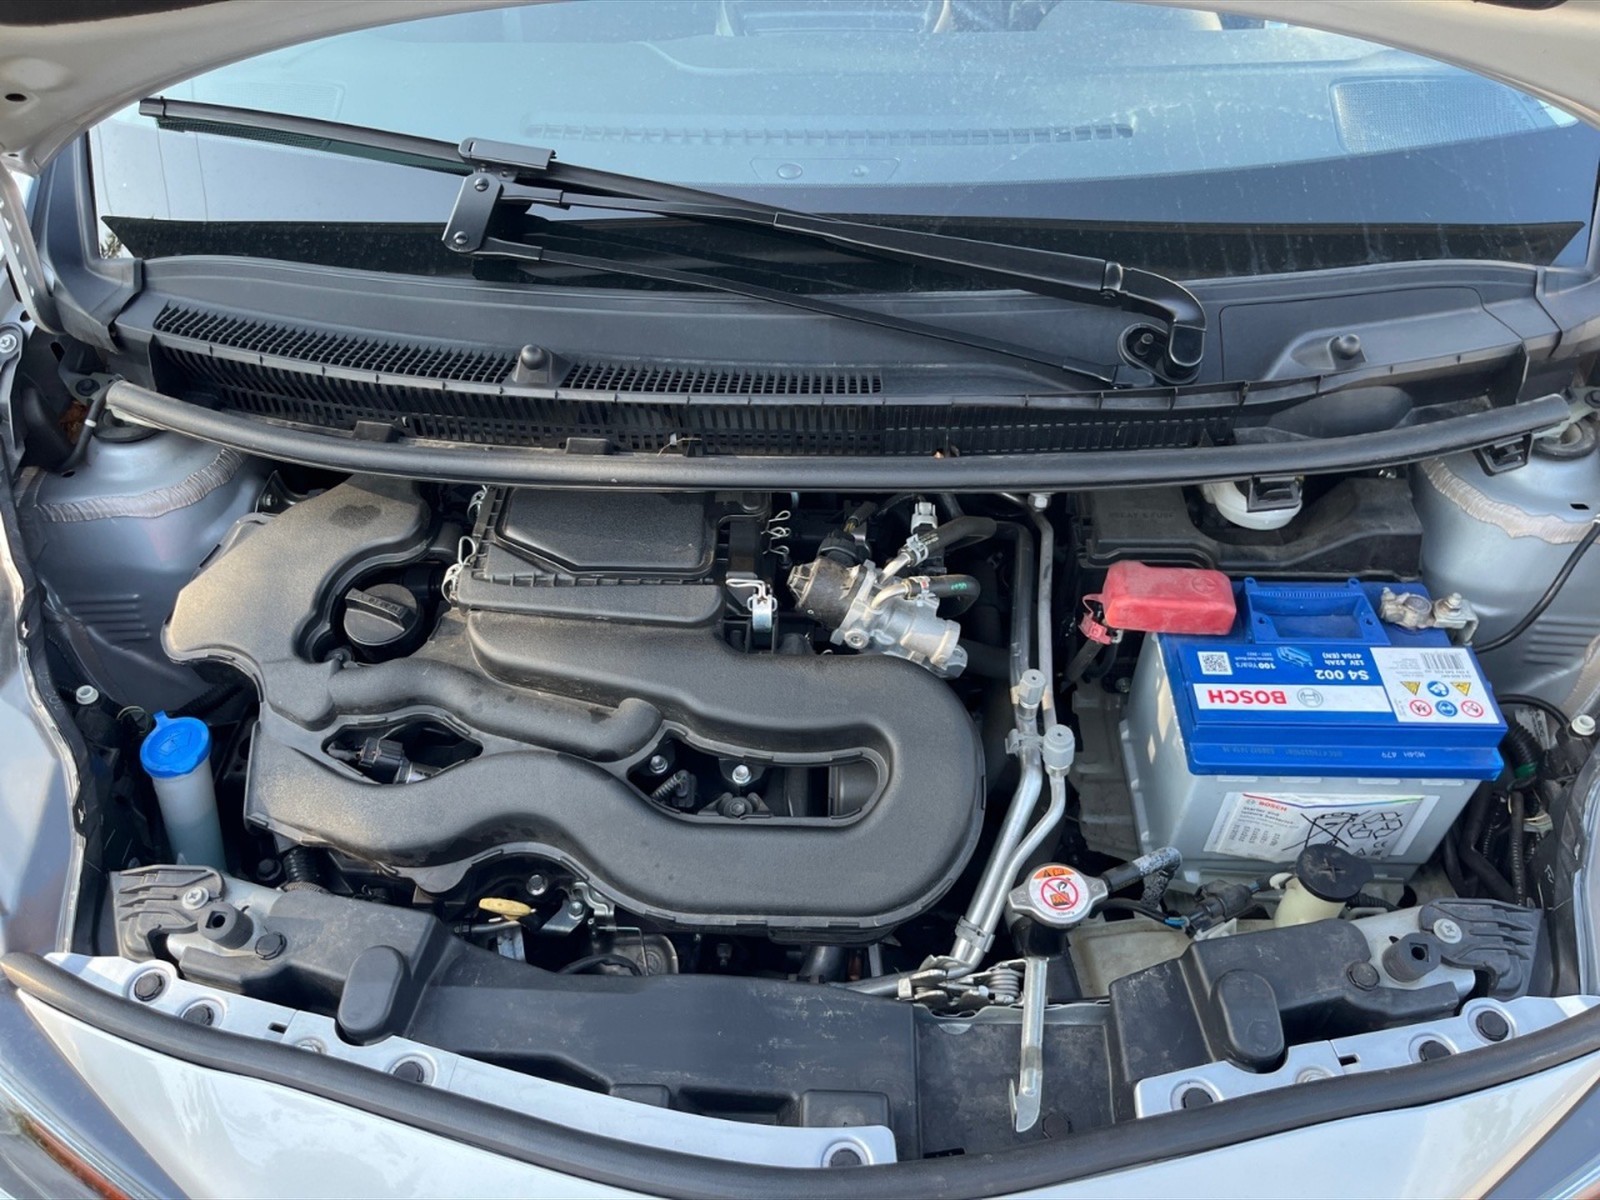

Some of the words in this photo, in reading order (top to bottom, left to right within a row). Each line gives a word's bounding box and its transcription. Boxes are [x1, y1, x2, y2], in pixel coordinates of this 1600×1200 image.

[1314, 669, 1344, 681] 002
[1347, 669, 1370, 680] S4
[1207, 689, 1287, 705] BOSCH
